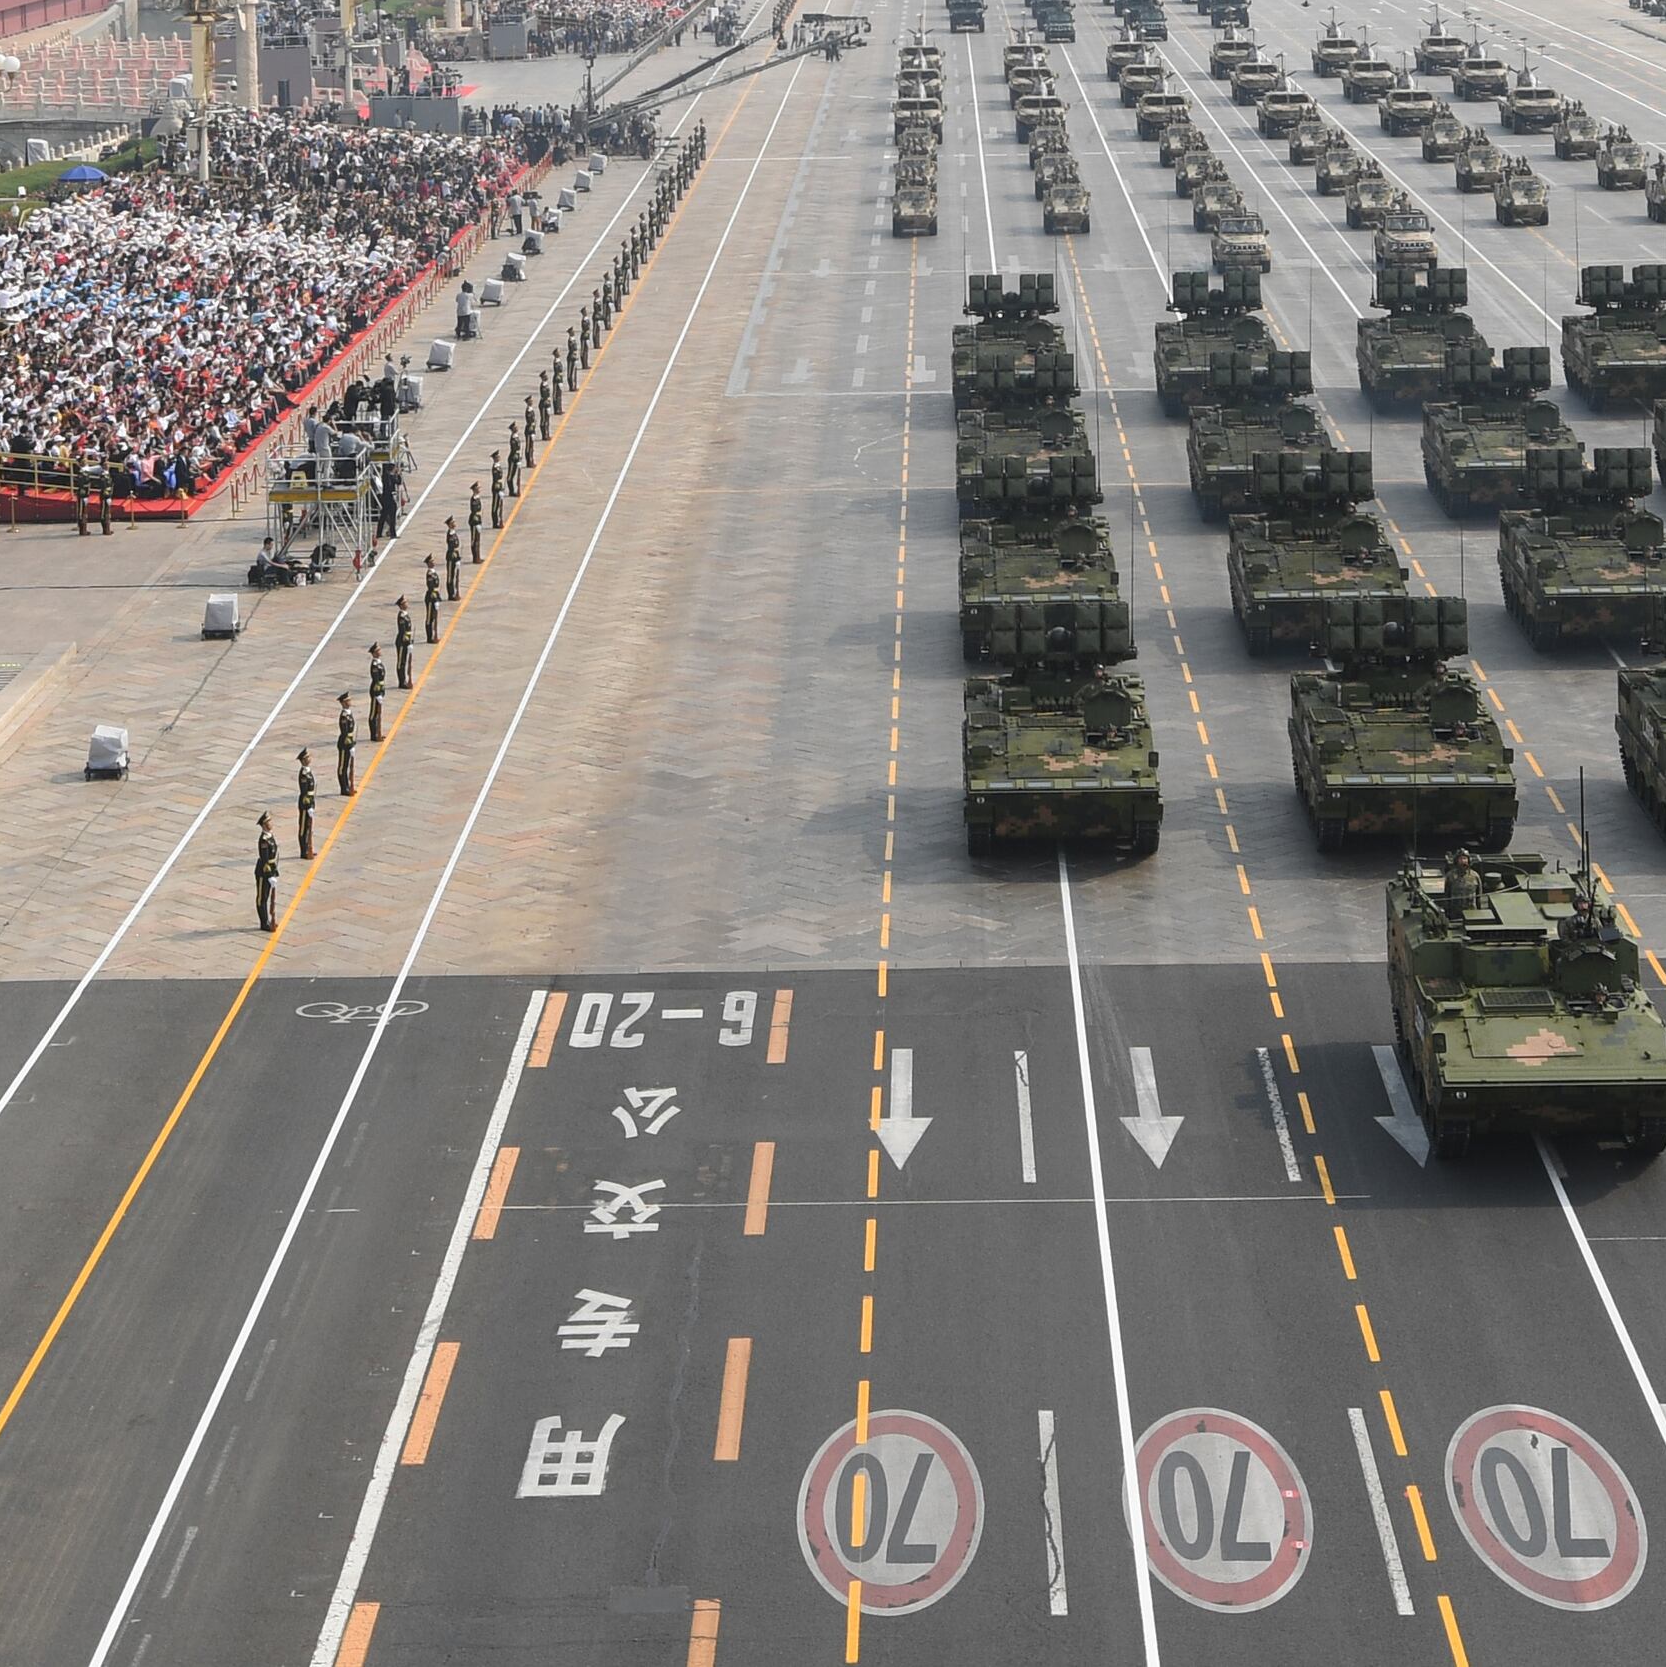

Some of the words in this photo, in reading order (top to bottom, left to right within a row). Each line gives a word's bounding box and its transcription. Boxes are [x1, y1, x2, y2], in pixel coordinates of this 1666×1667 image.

[834, 1451, 939, 1564] 70
[1158, 1449, 1273, 1563] 70
[1478, 1446, 1612, 1560] 70
